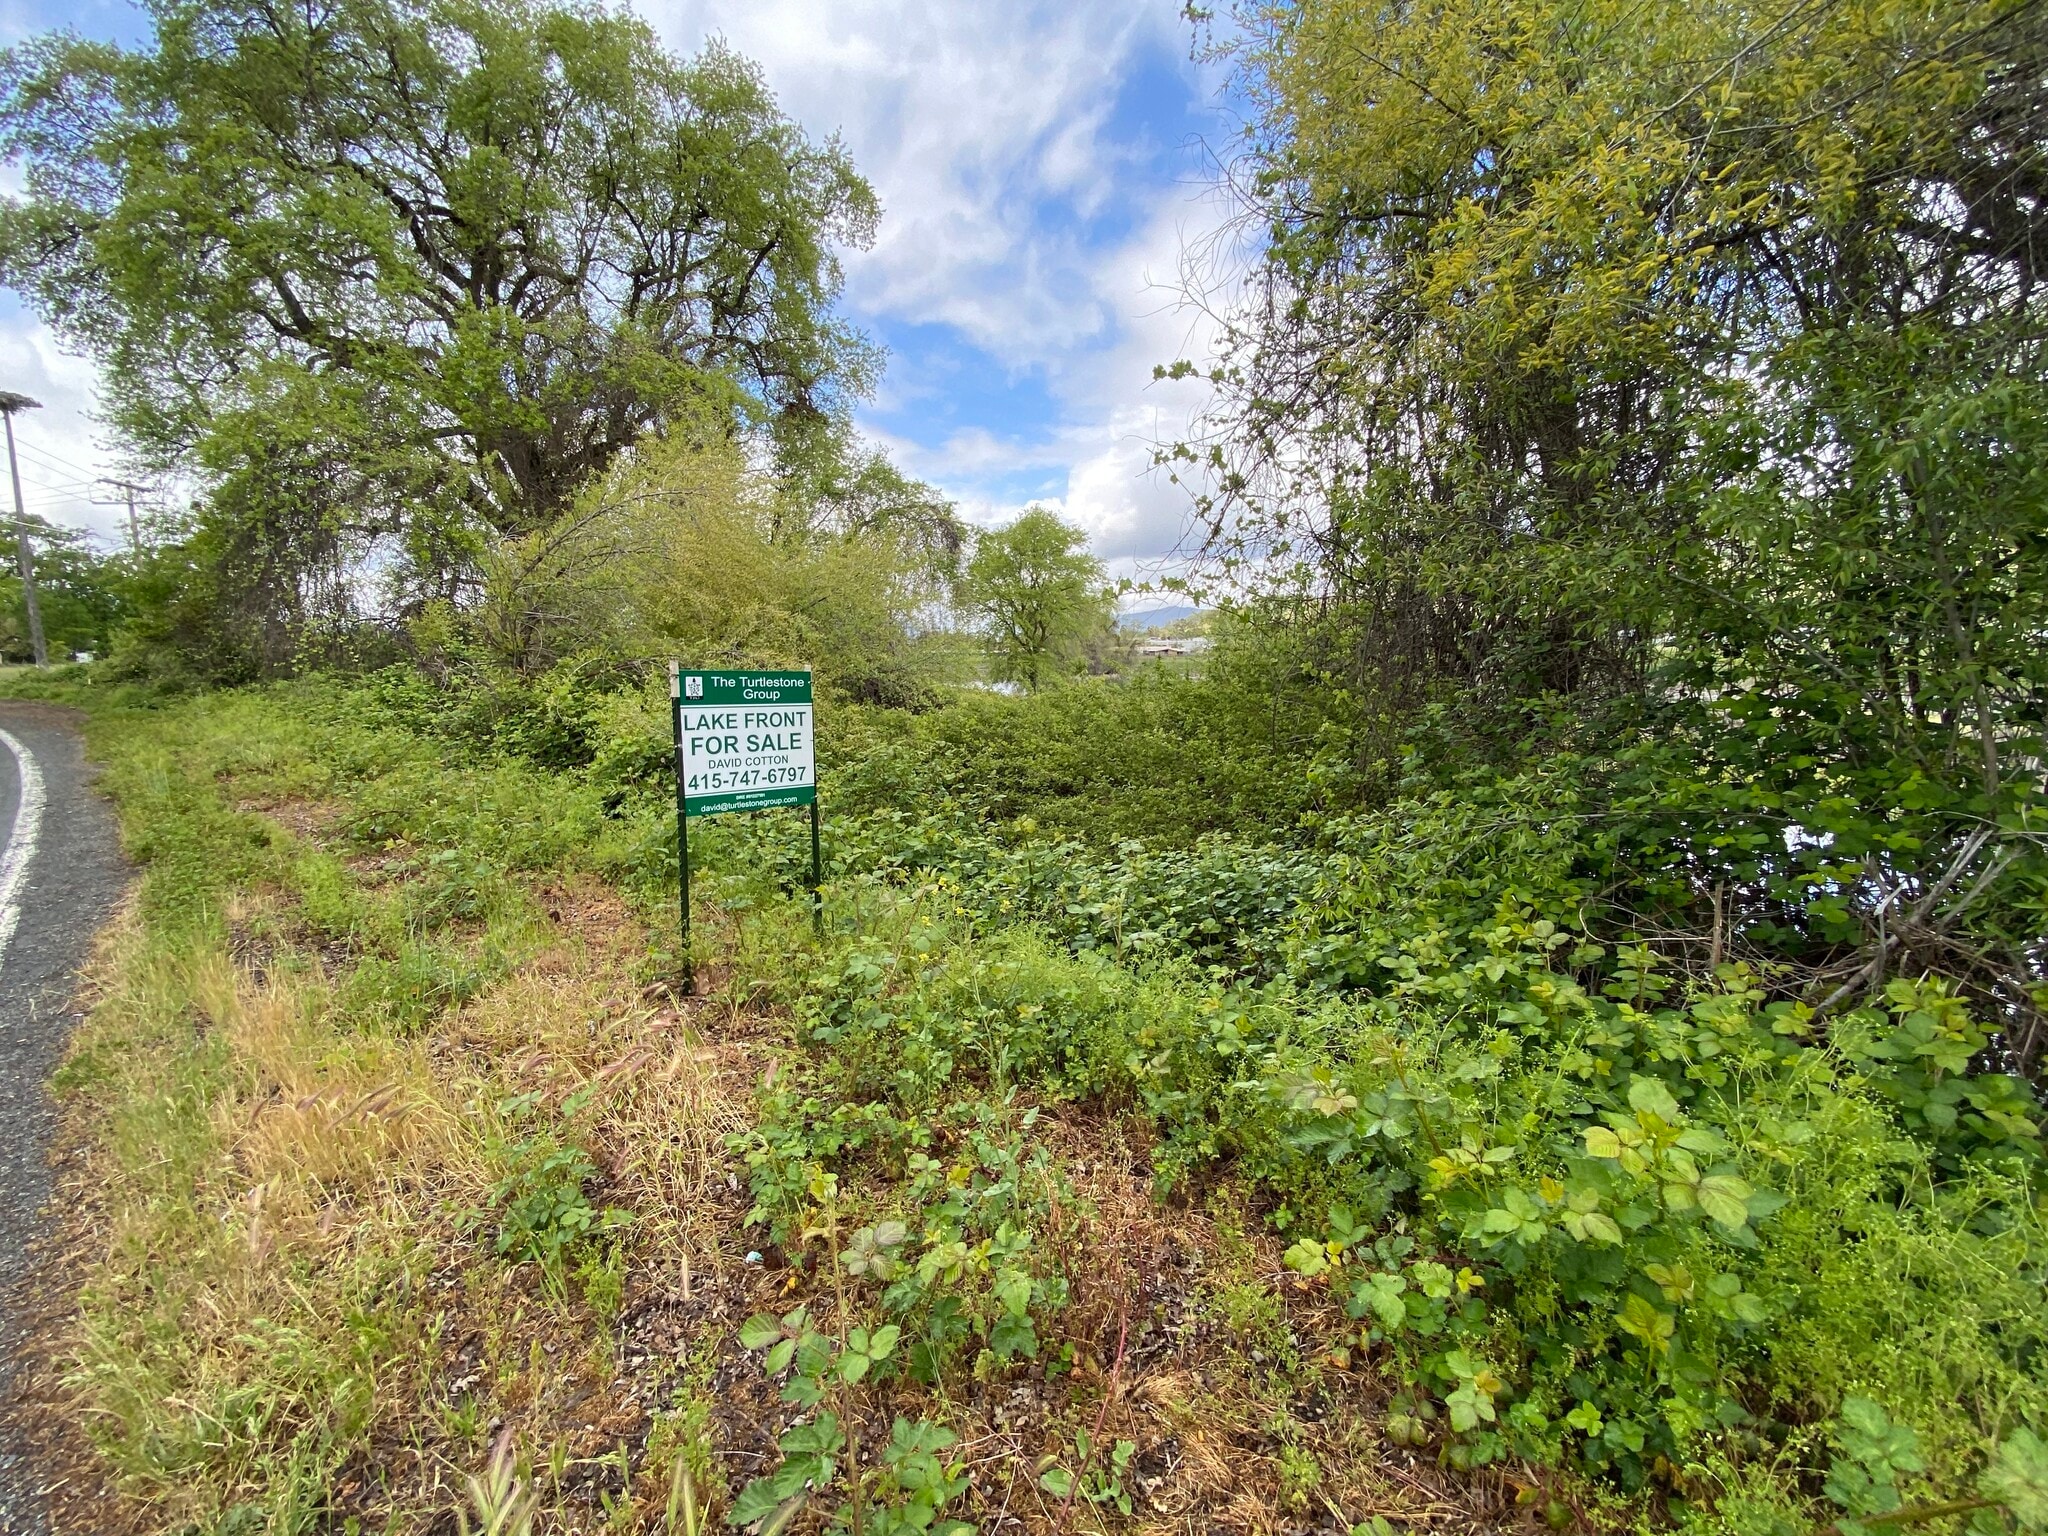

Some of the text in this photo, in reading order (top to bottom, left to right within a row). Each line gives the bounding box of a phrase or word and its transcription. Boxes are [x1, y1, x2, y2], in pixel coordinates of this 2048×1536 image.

[711, 676, 805, 687] The Turtlestone
[743, 689, 781, 701] Group
[684, 711, 807, 731] LAKE FRONT
[691, 732, 802, 755] FOR SALE
[708, 755, 789, 769] DAVID COTTON
[688, 766, 807, 790] 415-747-6797
[701, 796, 798, 812] david@turtlestonegroup.com
